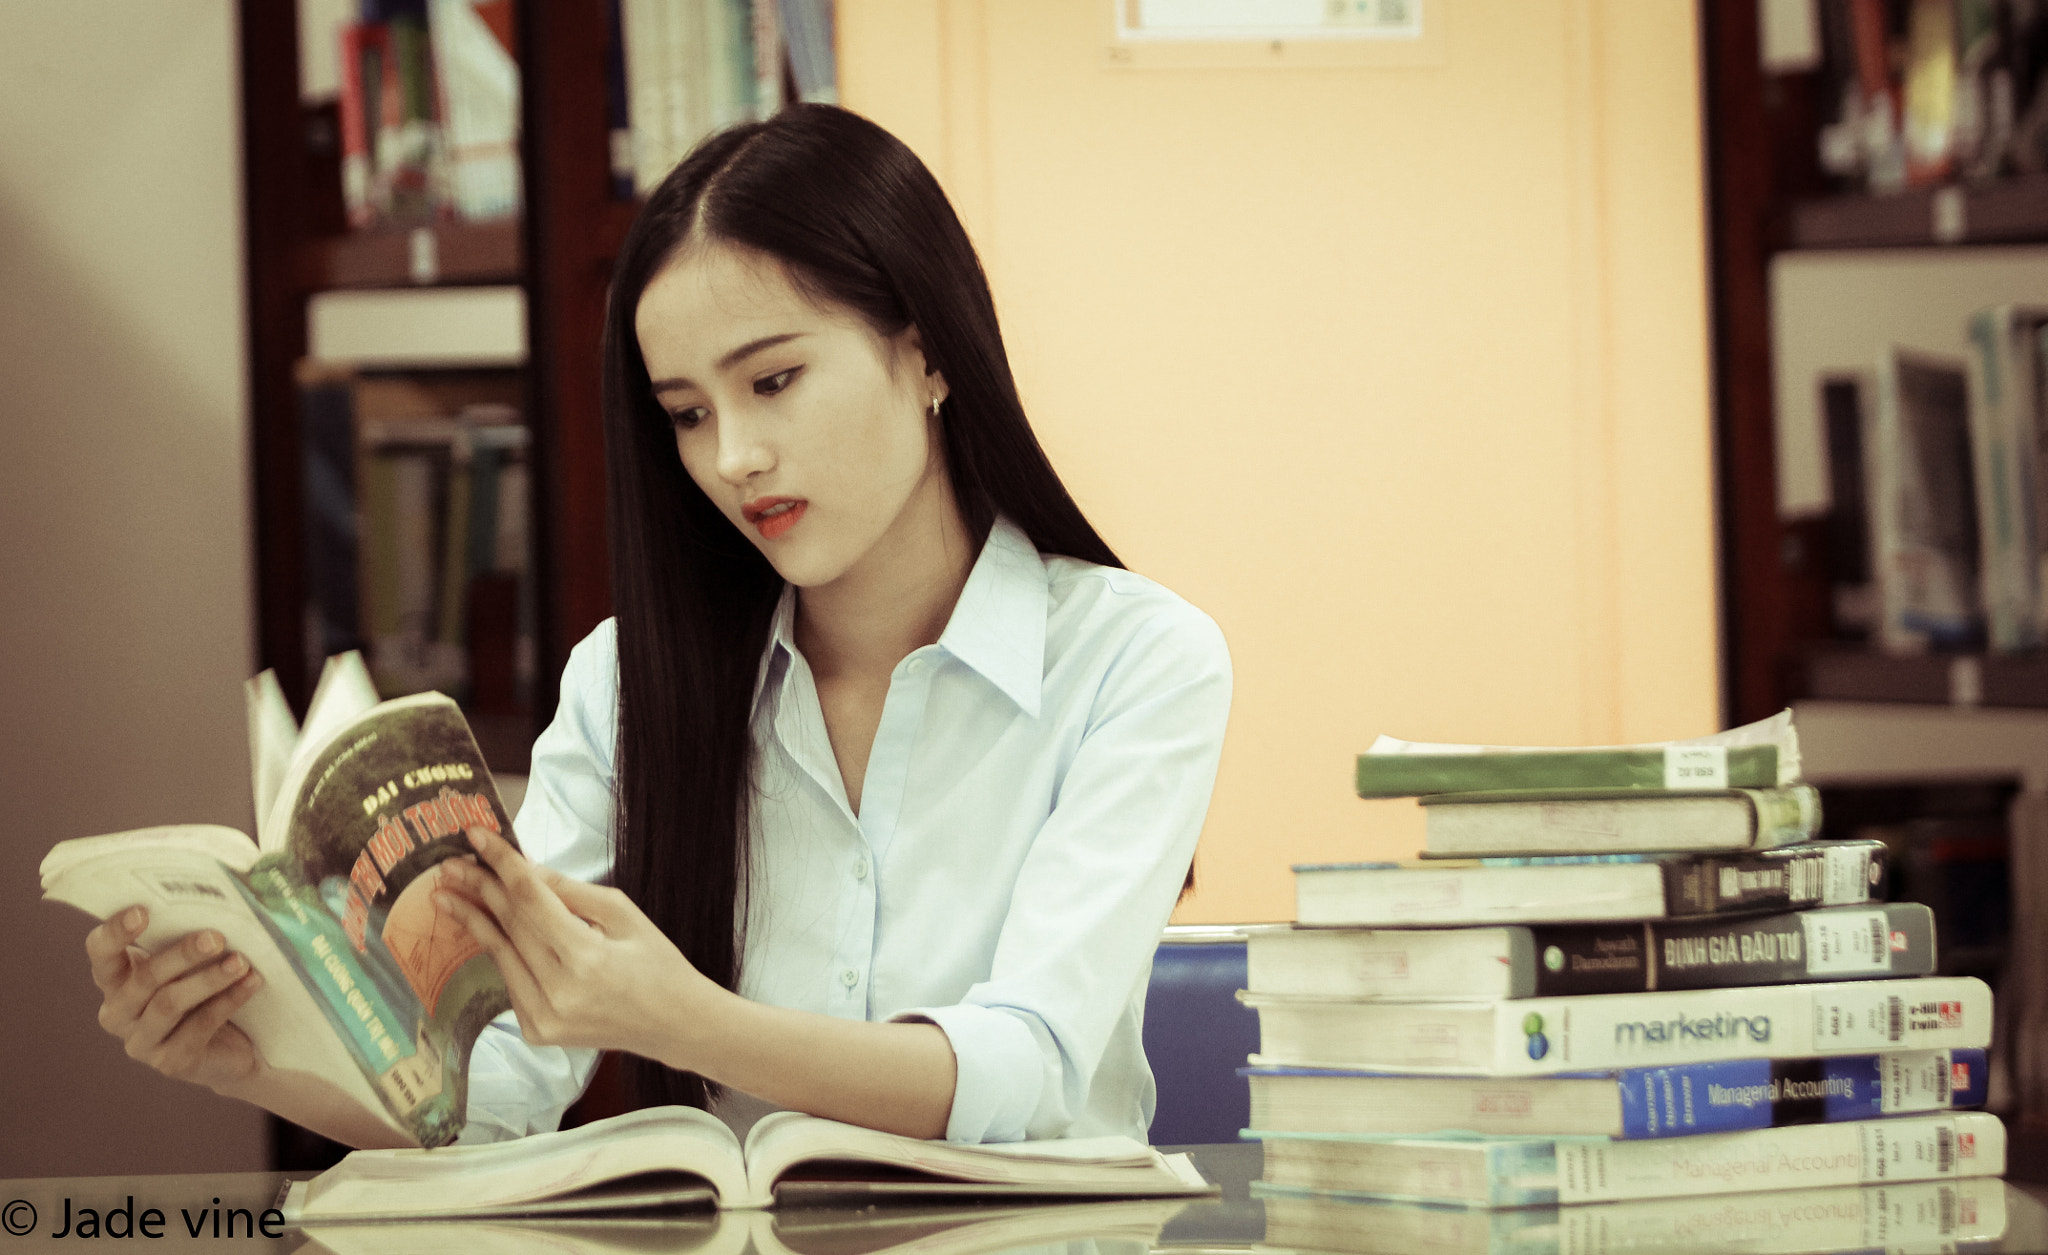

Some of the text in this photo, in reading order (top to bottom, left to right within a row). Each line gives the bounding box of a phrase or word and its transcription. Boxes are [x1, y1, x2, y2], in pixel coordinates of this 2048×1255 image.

[1614, 1012, 1771, 1044] marketing
[1708, 1079, 1780, 1108] Managerial
[1783, 1074, 1855, 1100] Accounting
[1673, 1157, 1770, 1181] Managerial
[1779, 1151, 1860, 1172] Accounti
